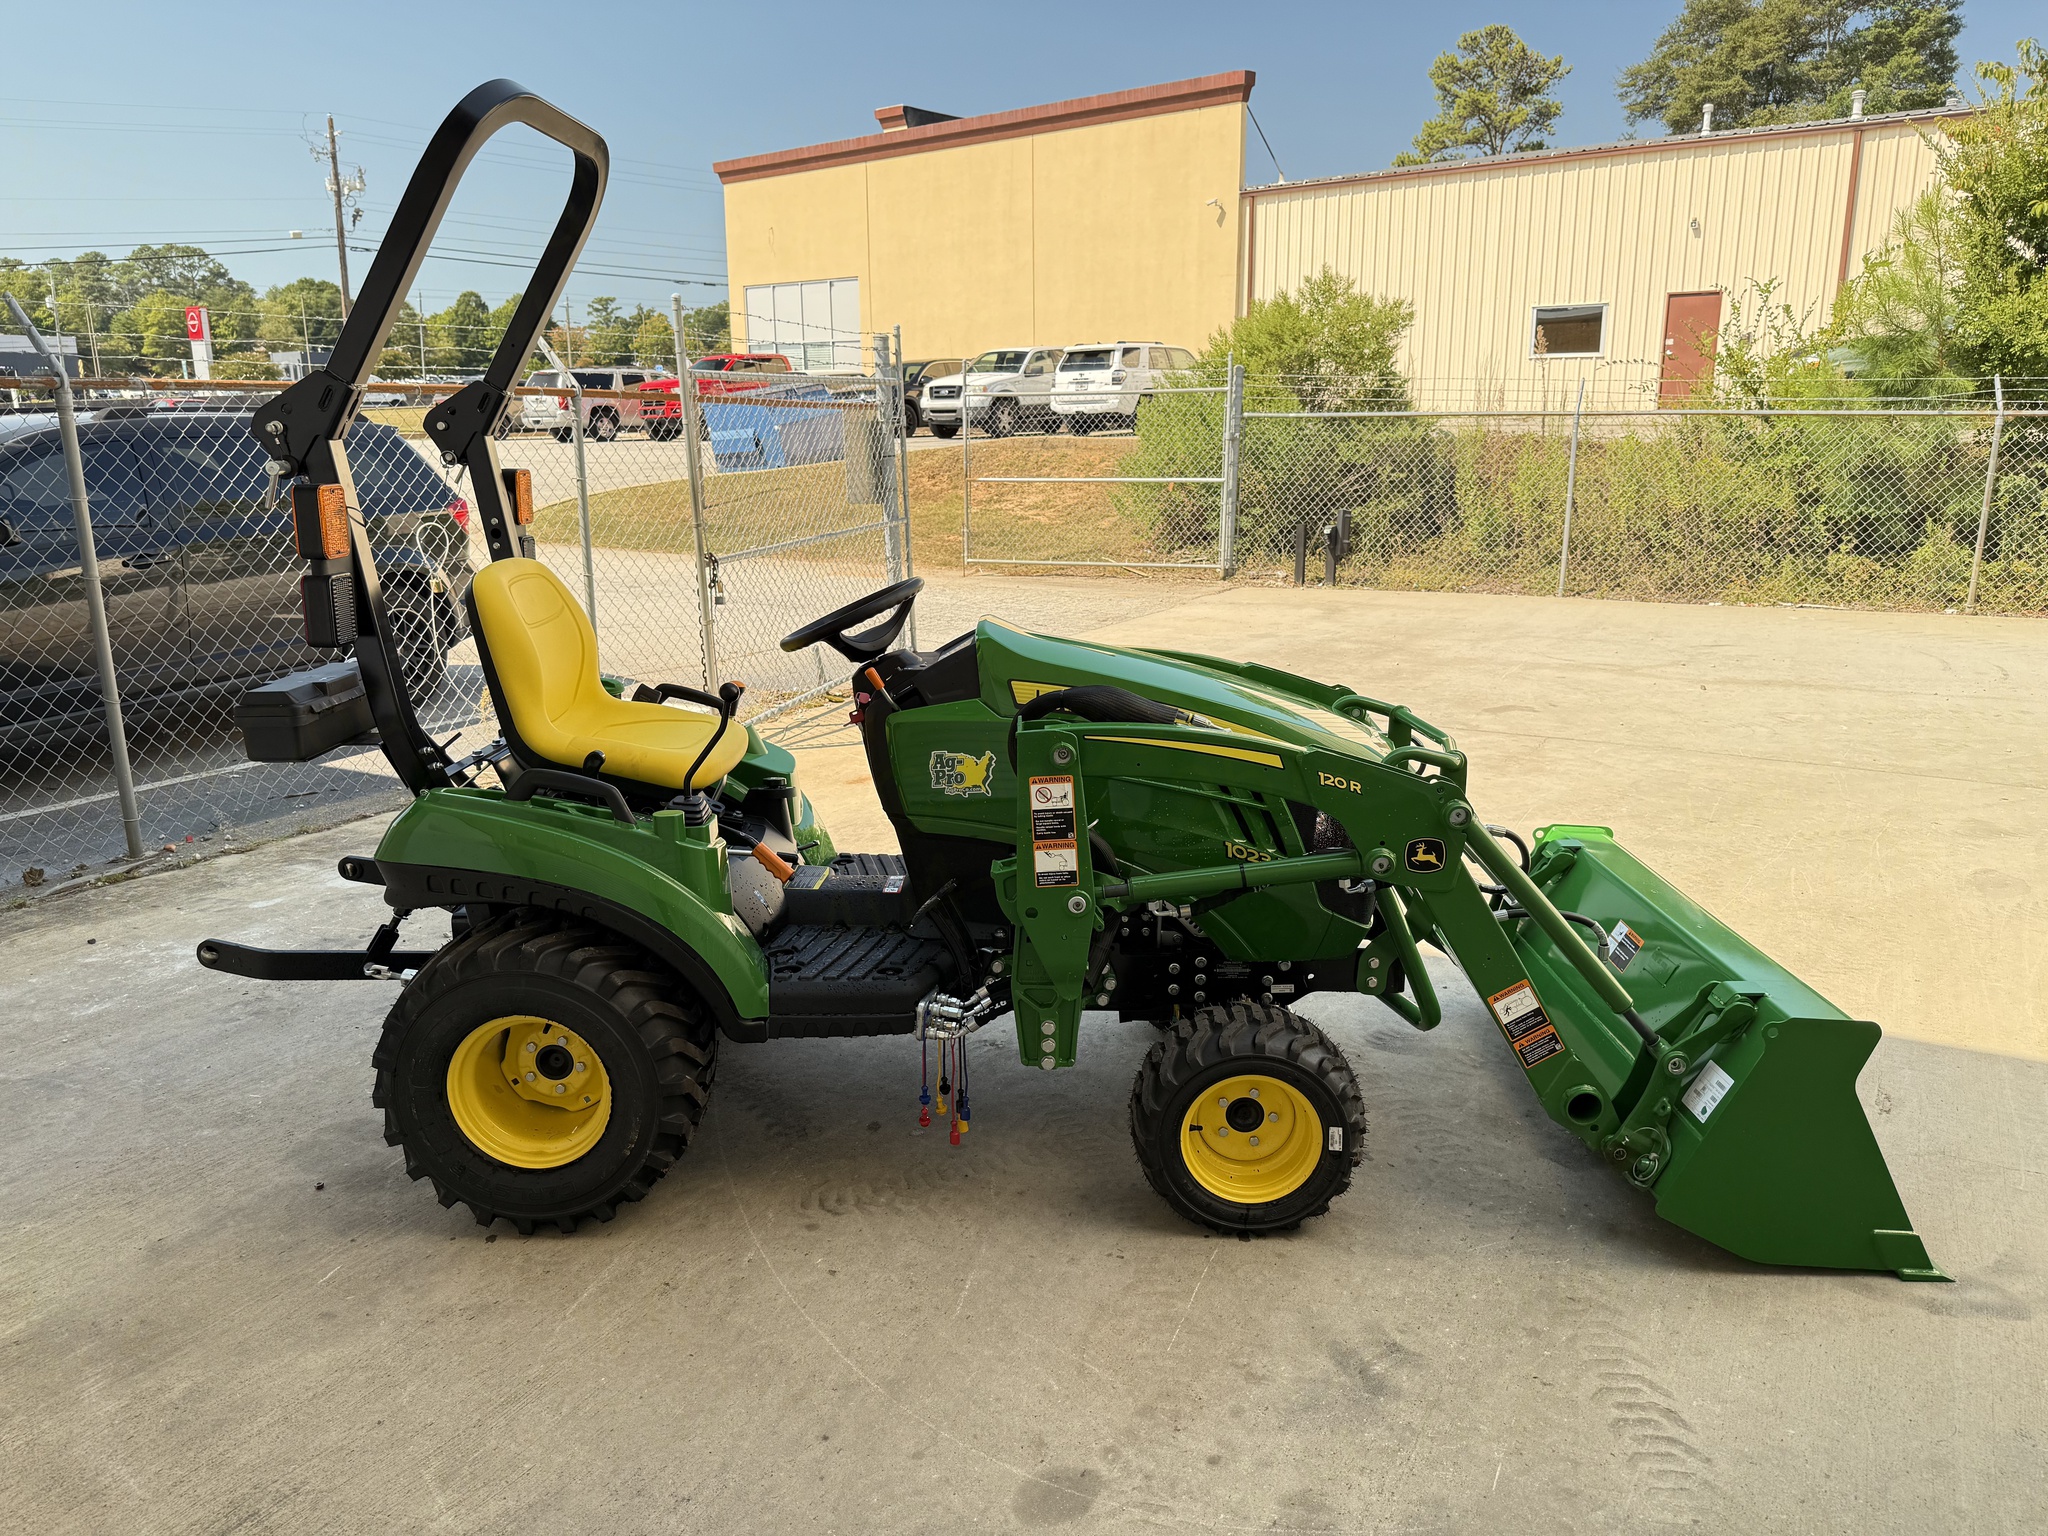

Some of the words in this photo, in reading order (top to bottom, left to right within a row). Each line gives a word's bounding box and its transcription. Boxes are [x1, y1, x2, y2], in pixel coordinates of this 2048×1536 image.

[932, 752, 964, 773] Ag-
[934, 770, 966, 787] Pro
[1317, 771, 1347, 789] 120
[1350, 780, 1362, 794] R
[1224, 841, 1281, 863] 1023
[1499, 983, 1525, 998] WARNING
[1525, 1029, 1551, 1044] WARNING
